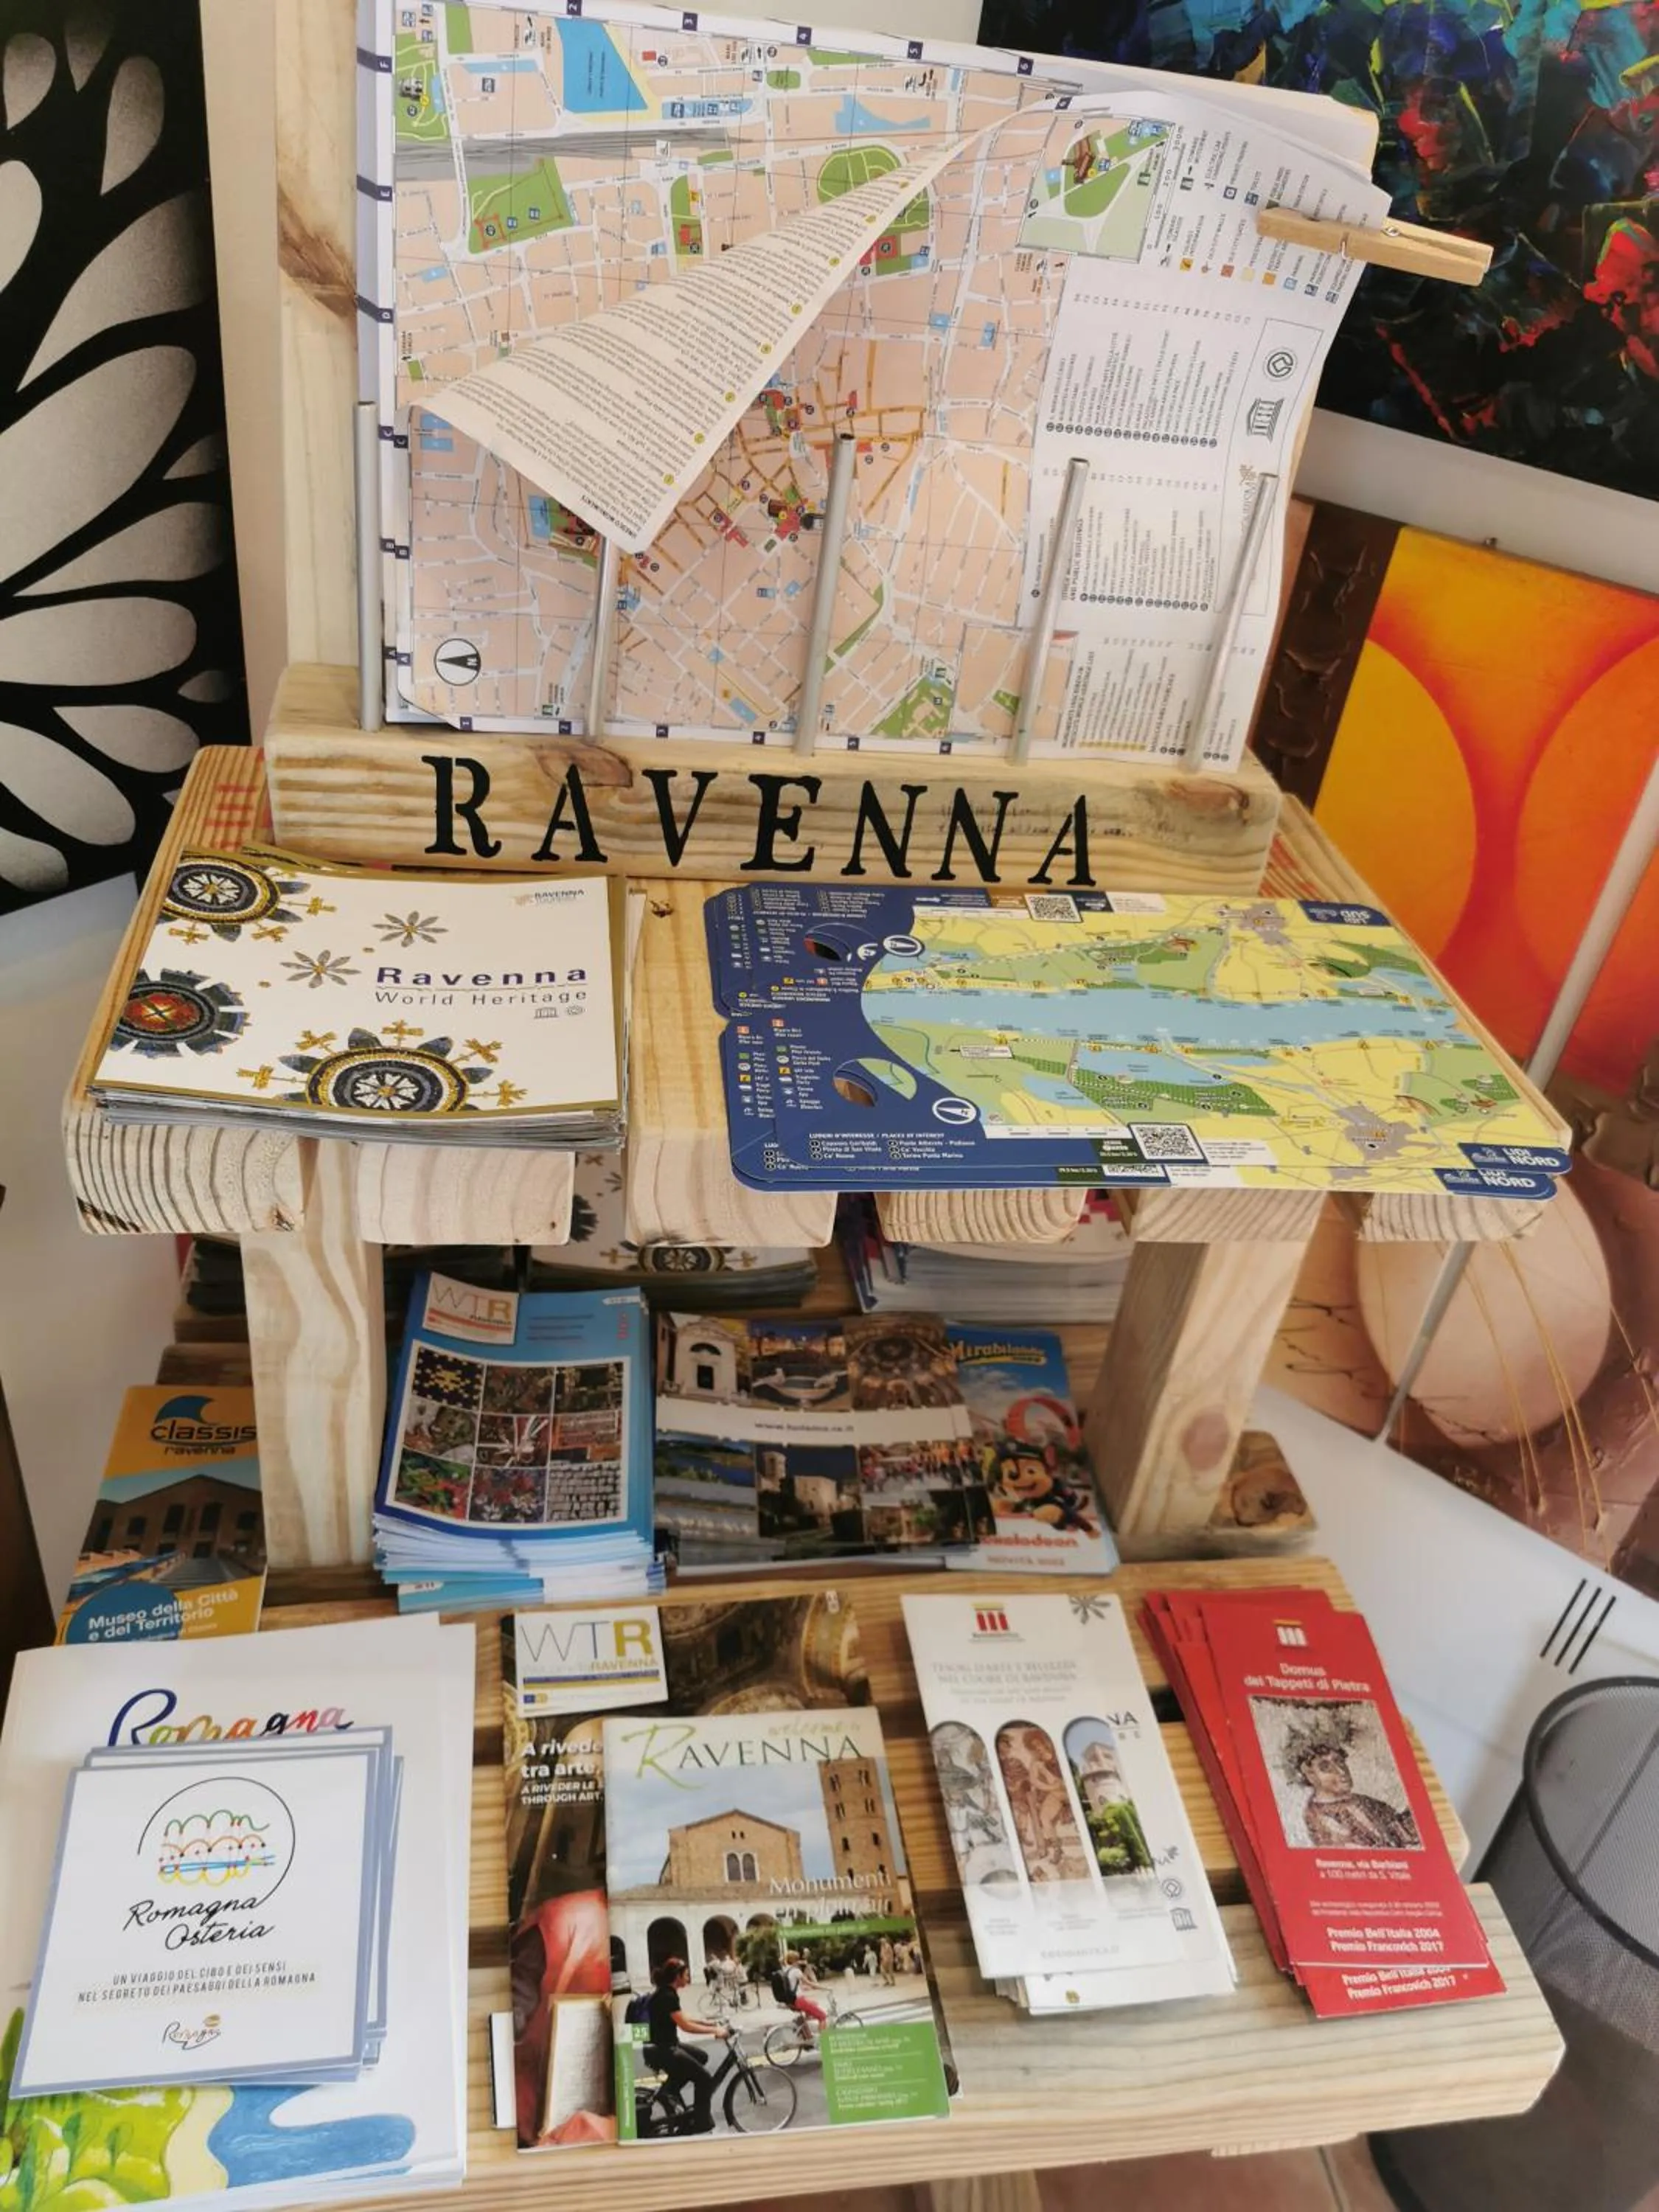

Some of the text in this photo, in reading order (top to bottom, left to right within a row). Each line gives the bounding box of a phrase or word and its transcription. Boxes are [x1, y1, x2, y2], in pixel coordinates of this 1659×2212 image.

[422, 755, 1096, 886] RAVENNA
[377, 967, 586, 986] Ravenna
[375, 990, 587, 1006] World Heritage
[1502, 1147, 1531, 1157] LIDI
[1509, 1155, 1560, 1168] NORD
[1484, 1176, 1537, 1188] NORD
[432, 1284, 512, 1320] WTR
[150, 1419, 257, 1440] classis
[164, 1446, 236, 1455] ravenna
[88, 1587, 238, 1630] Museo della Città
[88, 1631, 100, 1641] e
[104, 1624, 131, 1639] del
[137, 1607, 215, 1631] Territorio
[520, 1618, 654, 1663] WTR
[1265, 1675, 1315, 1691] Tappeti
[1316, 1678, 1330, 1690] di
[1331, 1679, 1371, 1693] Pietra
[521, 1738, 604, 1756] A rivede
[621, 1723, 866, 1792] RAVENNA
[521, 1764, 550, 1778] tra
[521, 1792, 577, 1805] THROUGH
[769, 1868, 892, 1896] Monumenti
[122, 1896, 260, 1931] Romagna
[164, 1921, 275, 1950] Osteria
[112, 1960, 287, 1986] UN VIAGGIO DEL CIBO E DEI SENSI
[77, 1972, 316, 2003] NEL SEGRETO DEI PAESAGGI DELLA ROMAGNA
